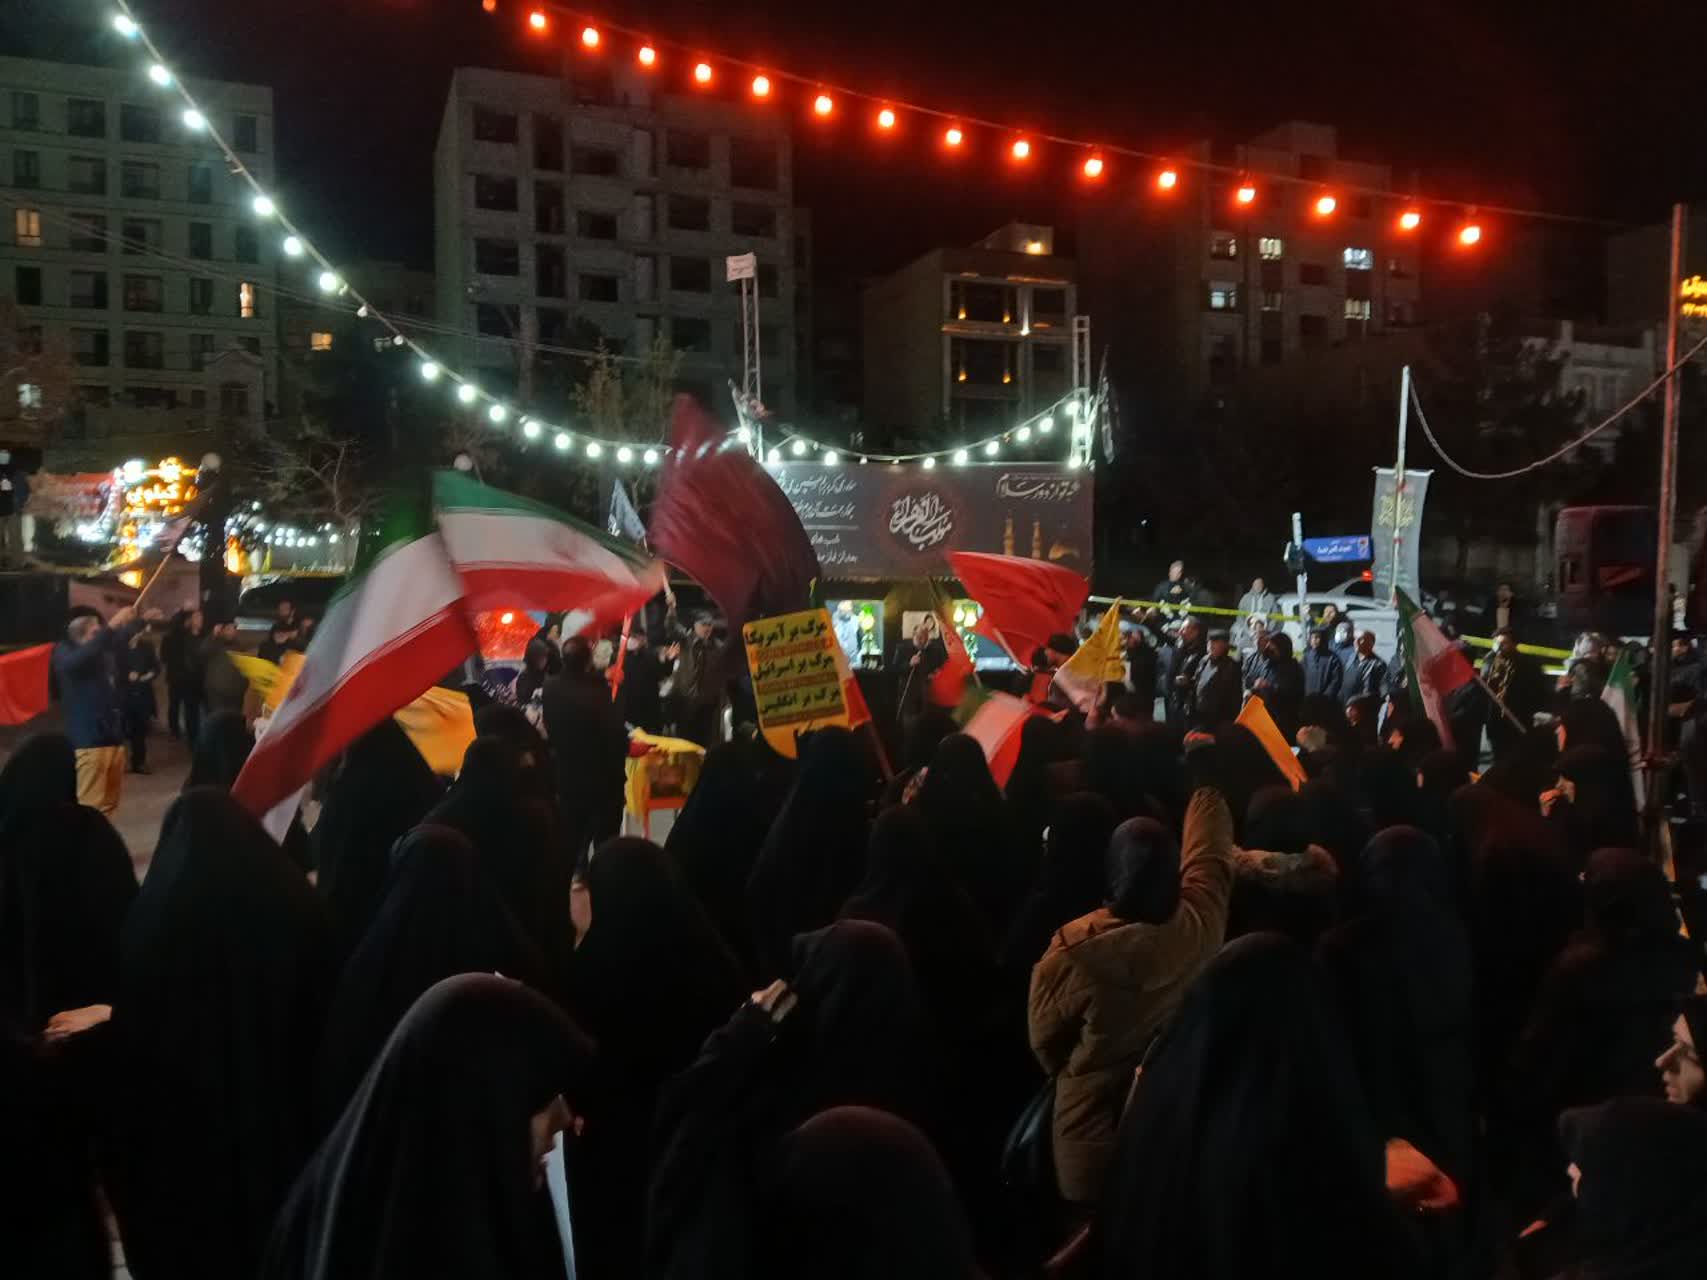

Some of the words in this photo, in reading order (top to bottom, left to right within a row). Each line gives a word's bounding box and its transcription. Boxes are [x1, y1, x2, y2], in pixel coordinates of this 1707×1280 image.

[744, 621, 785, 646] آمریکا
[789, 626, 799, 642] بر
[799, 618, 828, 637] مرگ
[798, 658, 808, 673] بر
[808, 651, 834, 669] مرگ
[813, 687, 840, 704] مرگ
